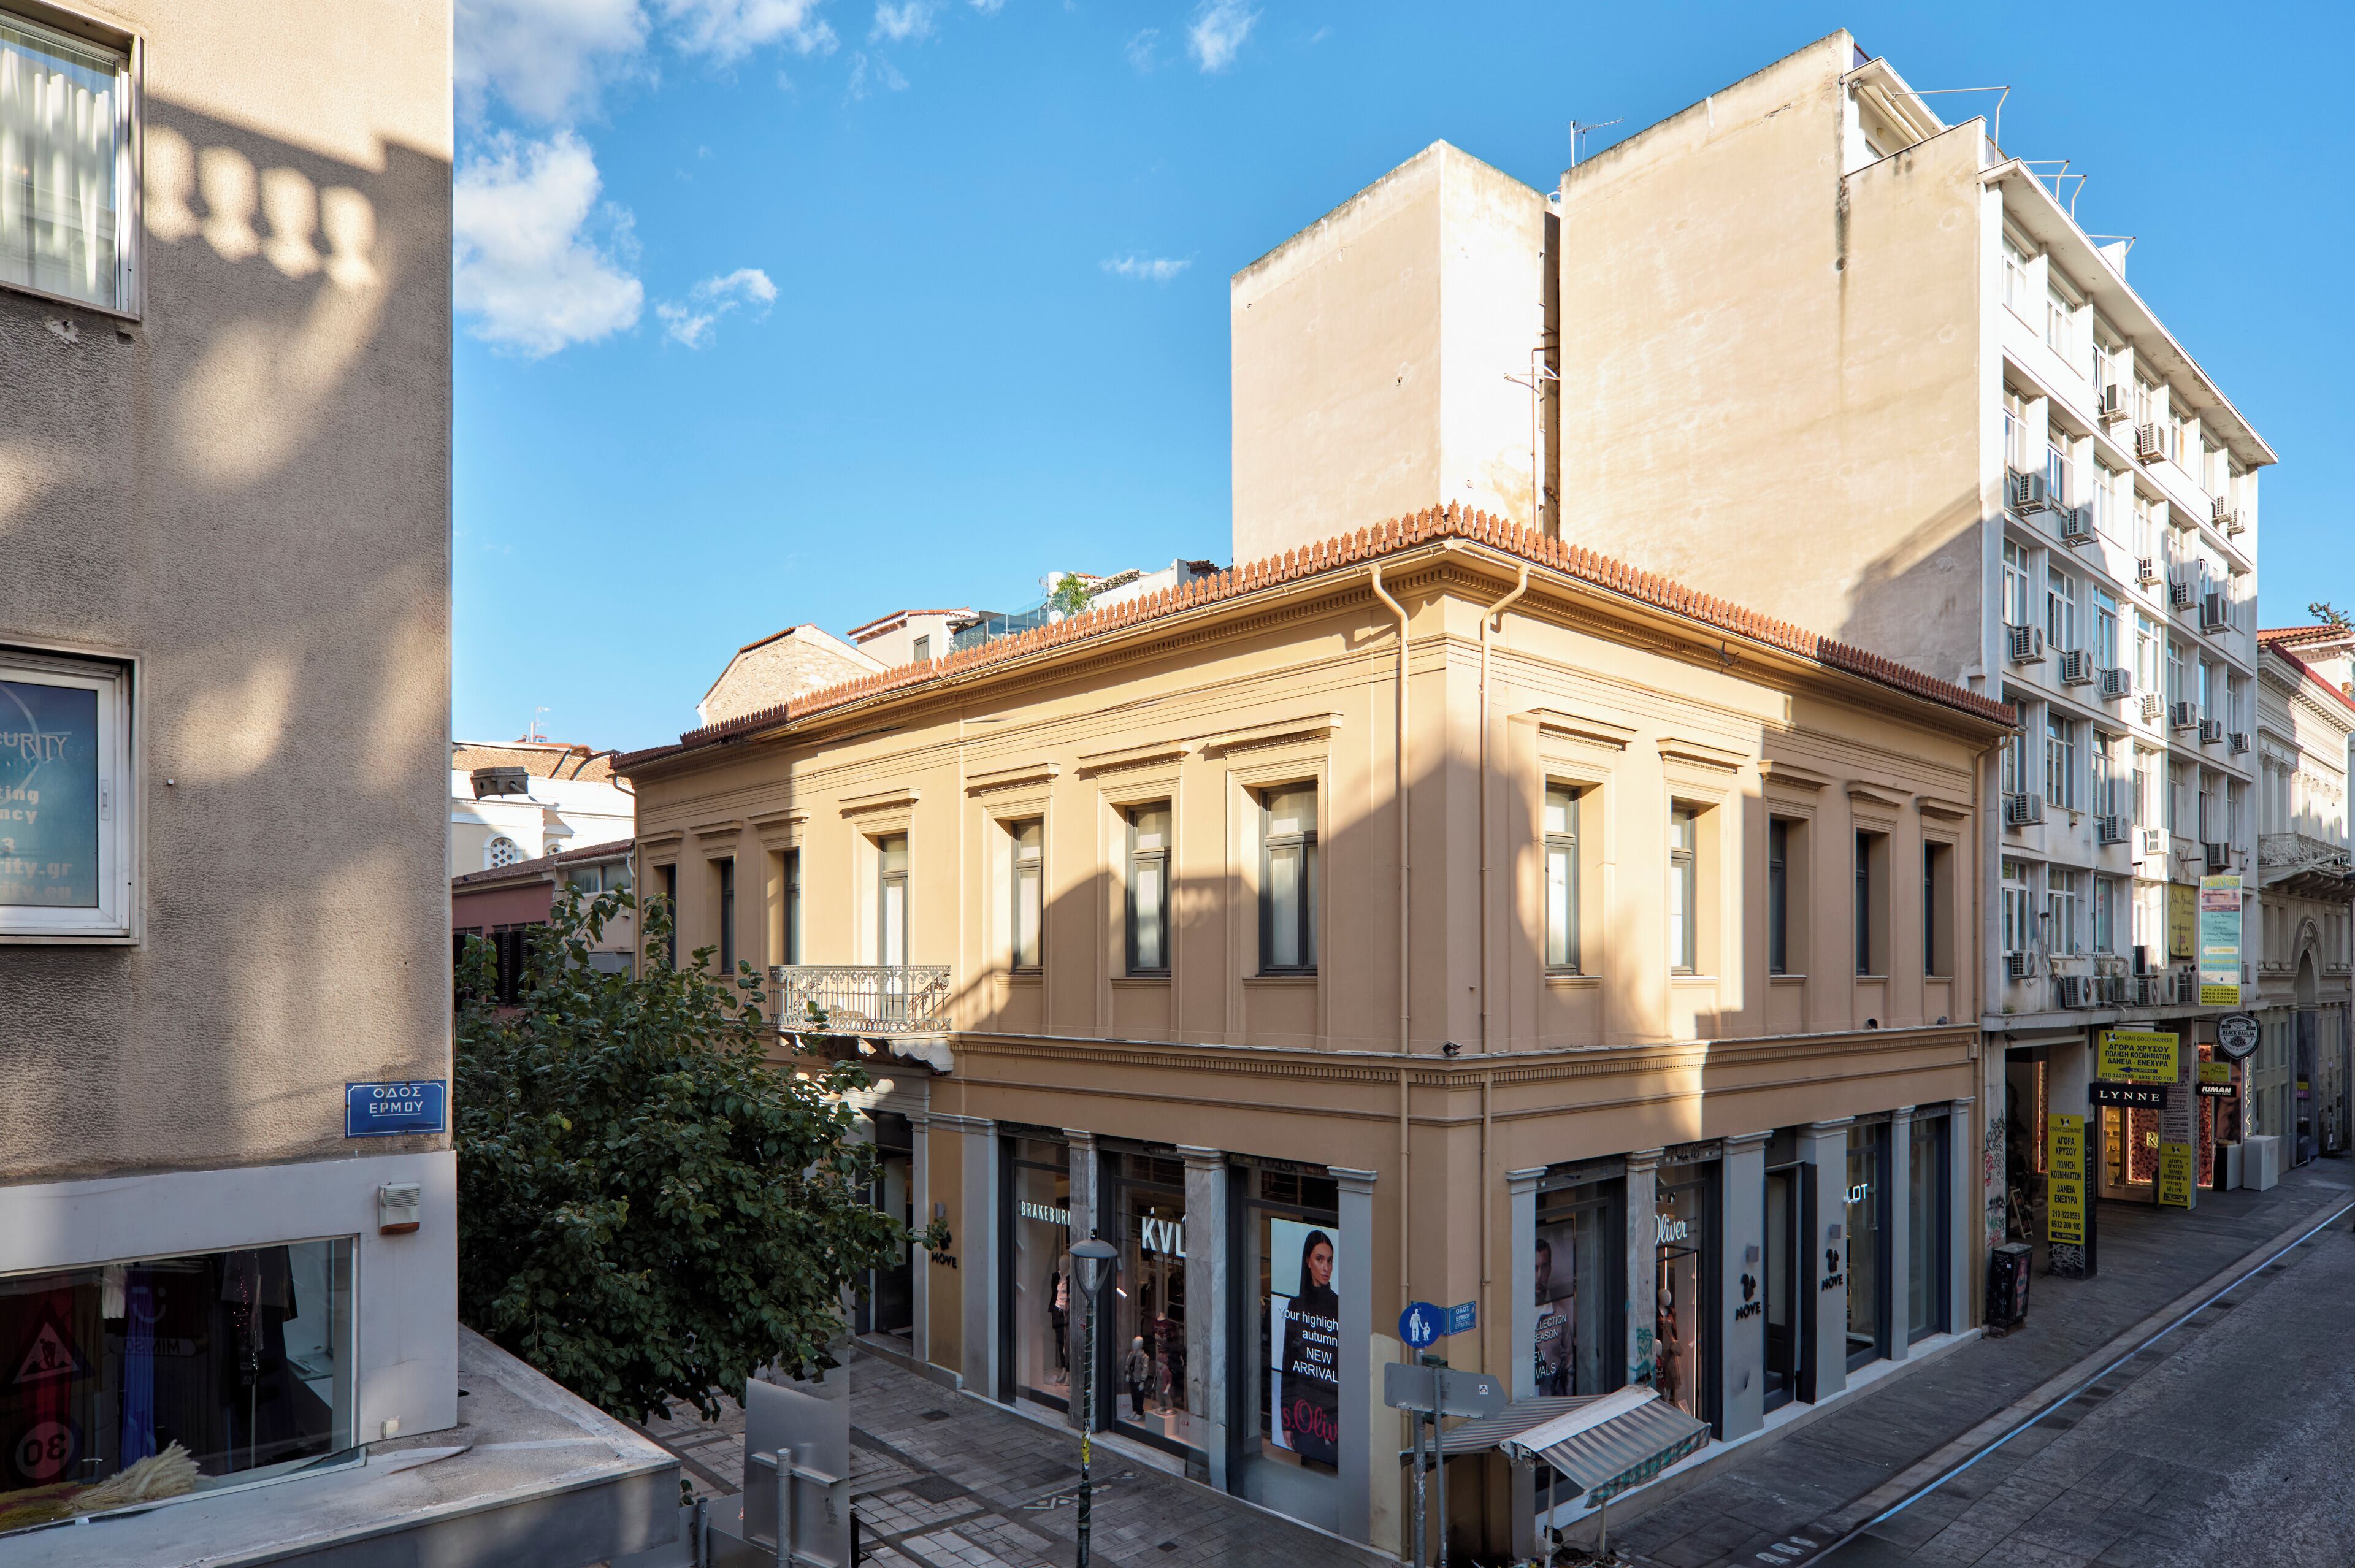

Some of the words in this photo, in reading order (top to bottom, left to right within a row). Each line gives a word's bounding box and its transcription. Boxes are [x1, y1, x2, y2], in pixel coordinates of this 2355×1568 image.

[373, 1087, 421, 1098] ΟΔΟΣ
[2100, 1090, 2159, 1101] LYNNE
[369, 1101, 423, 1114] ΕΡΜΟΥ
[2057, 1136, 2075, 1145] ΑΓΟΡΑ
[2055, 1146, 2077, 1156] ΧΡΥΣΟΥ
[2057, 1160, 2075, 1170] ΠΩΛΗΣΗ
[2051, 1169, 2081, 1180] ΚΟΣΜΗΜΑΤΩΝ
[2056, 1184, 2075, 1194] ΔΑΝΕΙΑ
[2054, 1195, 2078, 1205] ΕΝΕΧΥΡΑ
[2061, 1211, 2080, 1220] 3223555
[2051, 1220, 2062, 1228] 6932
[2063, 1221, 2072, 1230] 200
[932, 1252, 957, 1269] MOVE
[1821, 1274, 1843, 1291] MOVE
[1279, 1306, 1300, 1321] Your
[1455, 1306, 1469, 1314] ΟΔΟΣ
[1736, 1301, 1761, 1321] MOVE
[1455, 1314, 1470, 1322] ΕΡΜΟΥ
[1302, 1329, 1338, 1347] autumn
[1306, 1347, 1332, 1364] NEW
[1292, 1360, 1338, 1383] ARRIVAL
